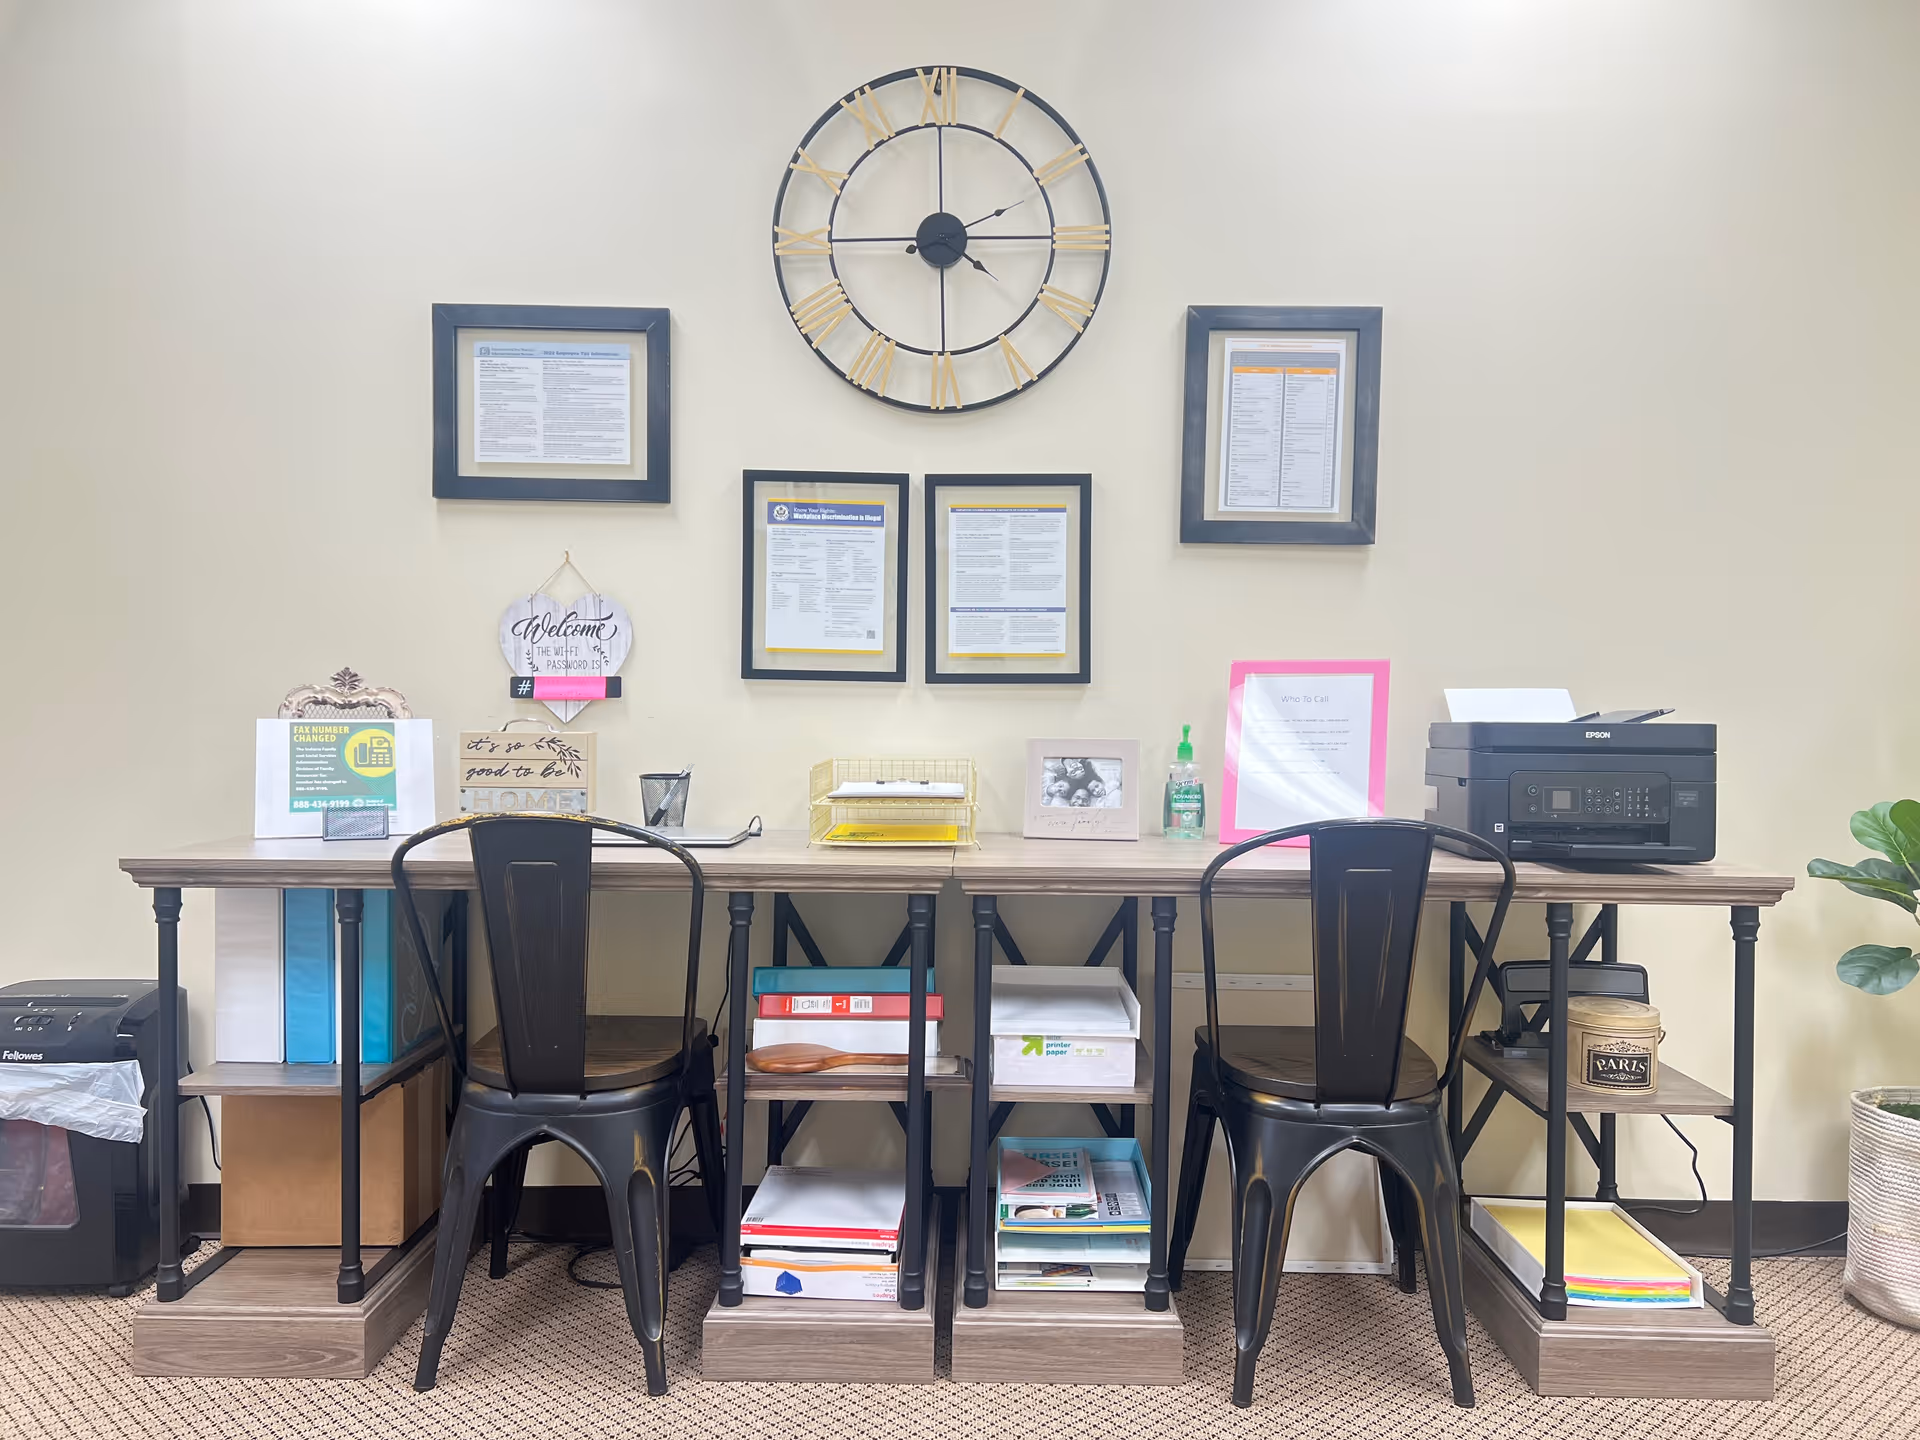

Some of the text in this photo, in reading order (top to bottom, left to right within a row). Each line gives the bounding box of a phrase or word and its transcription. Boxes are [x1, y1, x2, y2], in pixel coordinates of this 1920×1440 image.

[511, 611, 618, 644] Welcome
[536, 646, 579, 656] THE WI-FI
[546, 660, 600, 670] PASSWORD IS
[1281, 695, 1329, 703] Who To Call
[293, 726, 350, 734] FAX NUMBER
[1585, 731, 1611, 739] EPSON
[293, 734, 337, 743] CHANGED
[467, 736, 526, 753] it's so
[466, 763, 510, 781] good
[512, 765, 534, 778] to
[473, 791, 573, 811] HOME
[3, 1051, 43, 1061] Fellowes
[1594, 1058, 1648, 1073] PARIS
